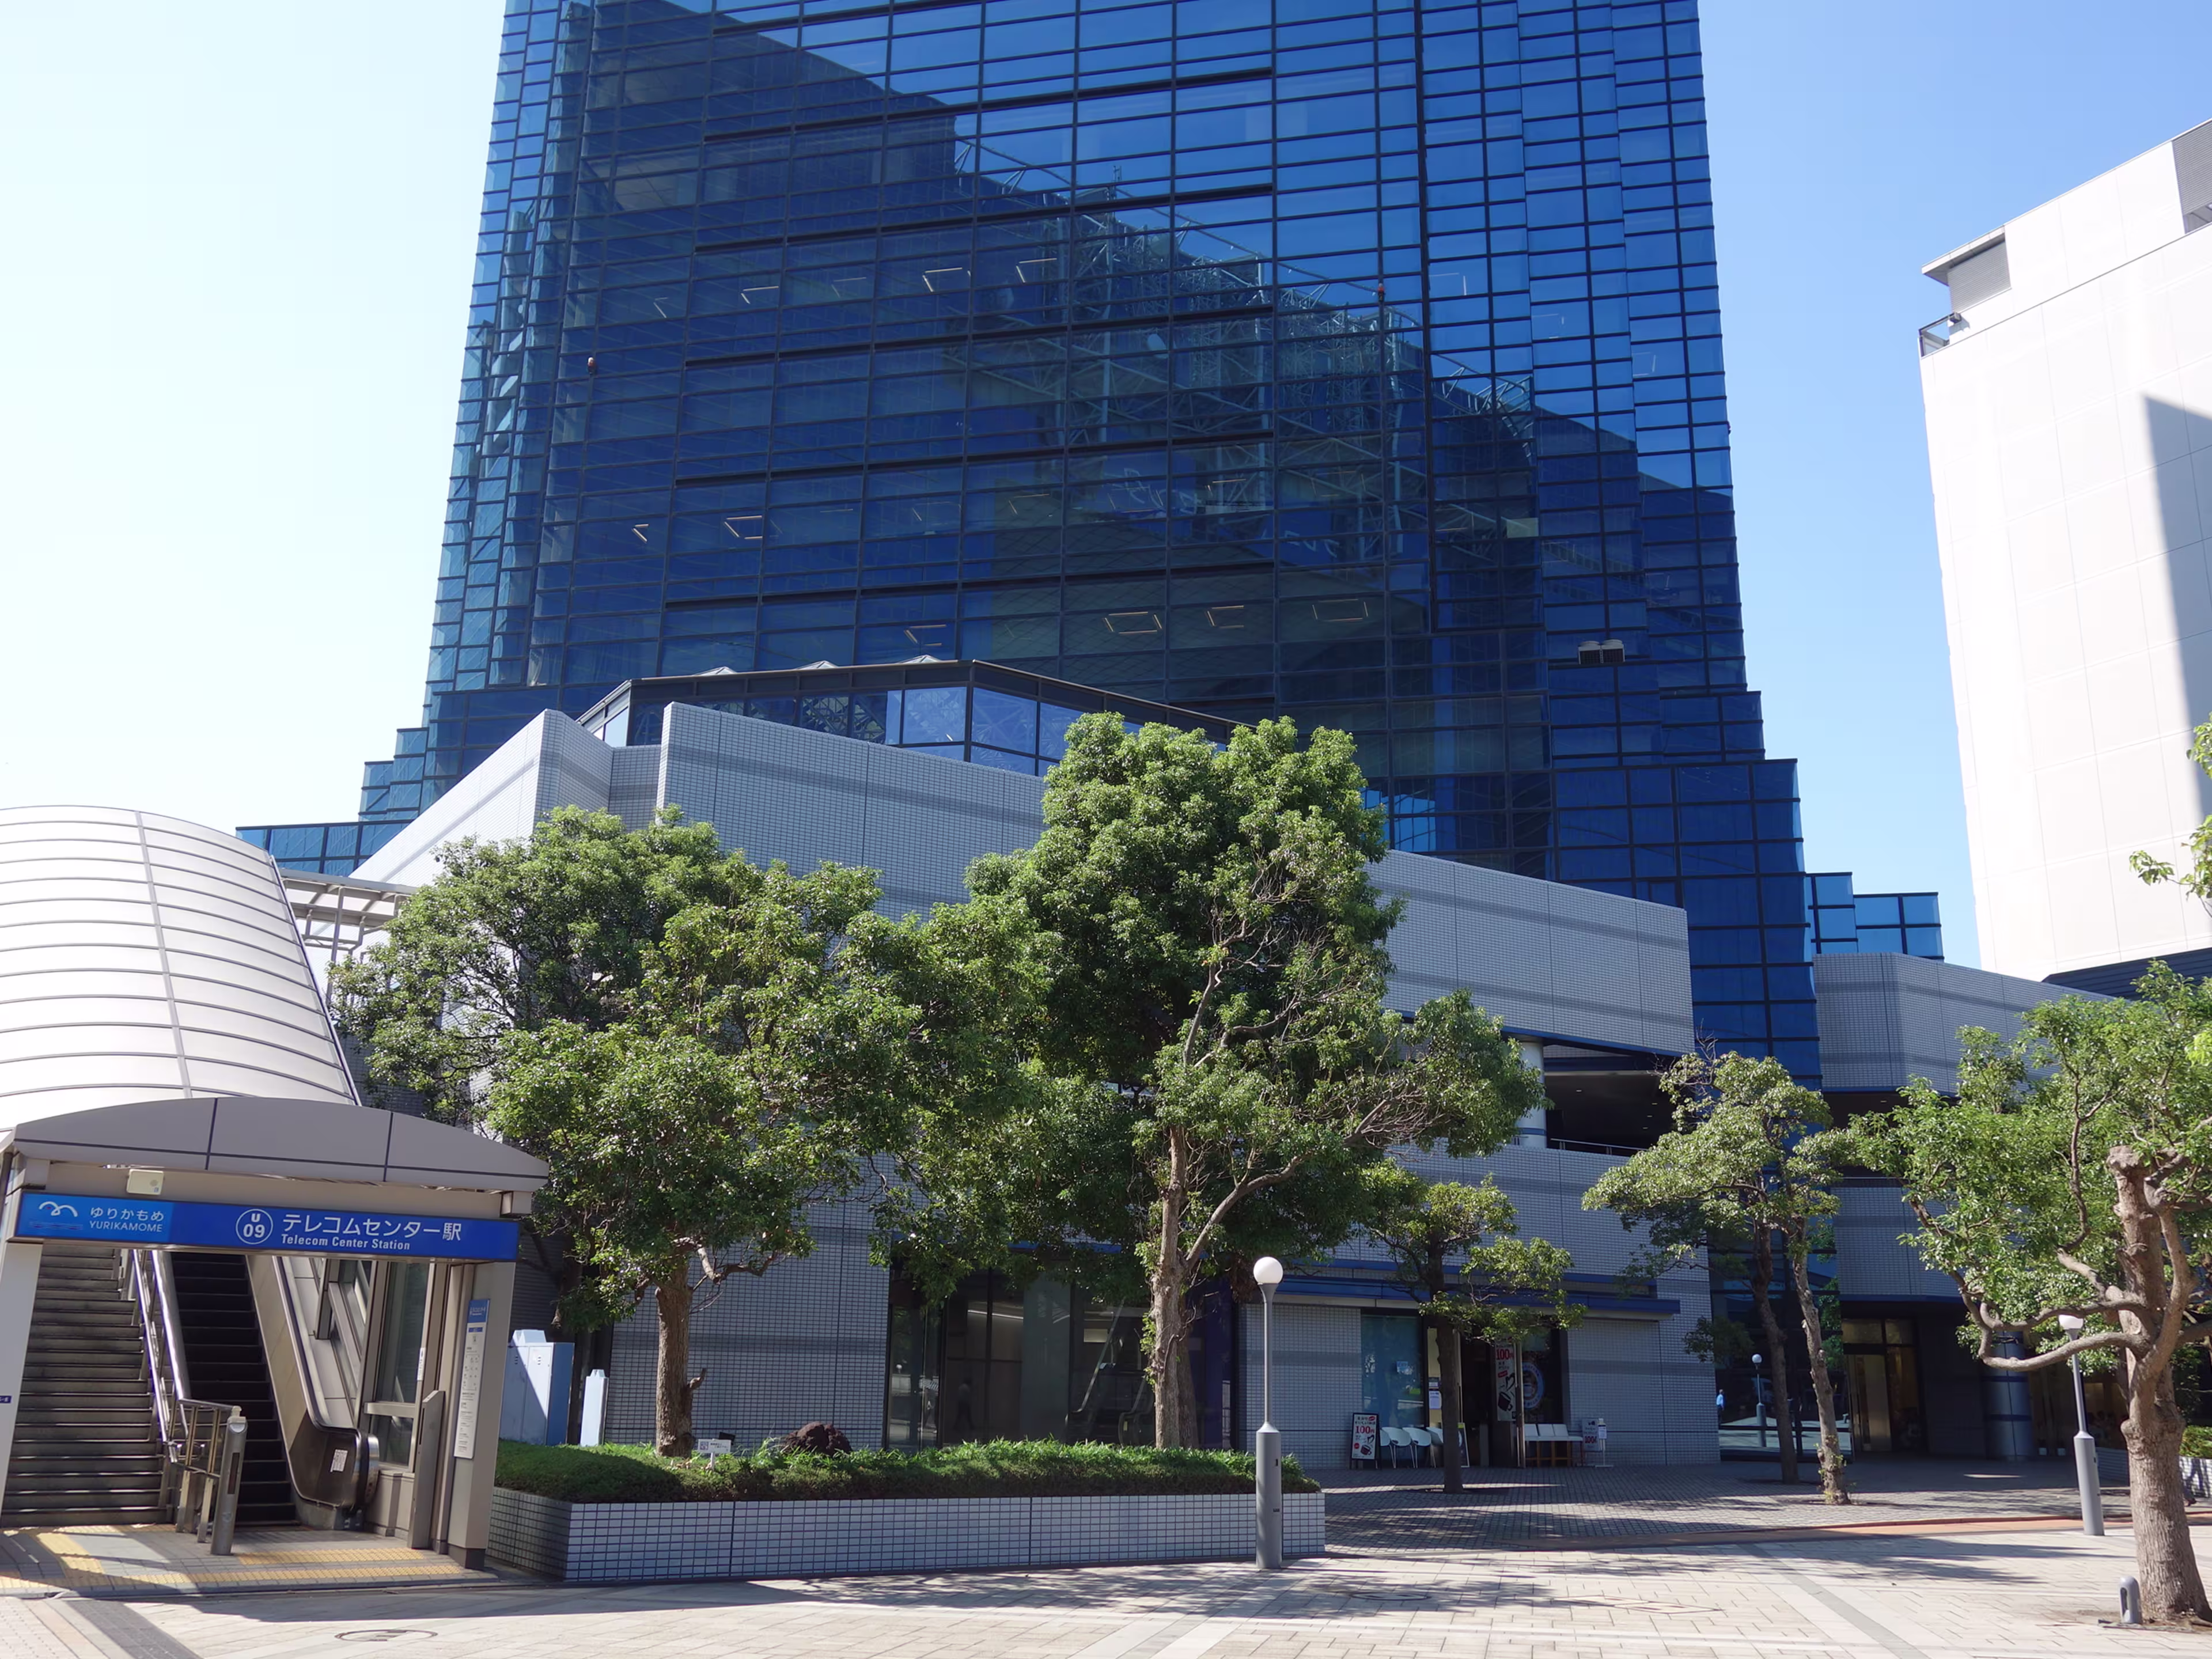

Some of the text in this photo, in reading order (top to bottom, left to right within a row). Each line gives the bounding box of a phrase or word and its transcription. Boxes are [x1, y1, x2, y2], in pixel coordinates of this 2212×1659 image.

[90, 1207, 164, 1222] ゆりかもめ
[251, 1213, 261, 1222] U
[89, 1220, 162, 1232] YURIKAMOME
[243, 1224, 265, 1238] 09
[283, 1214, 461, 1241] テレコムセンター駅
[281, 1234, 411, 1250] Telecom Center Station
